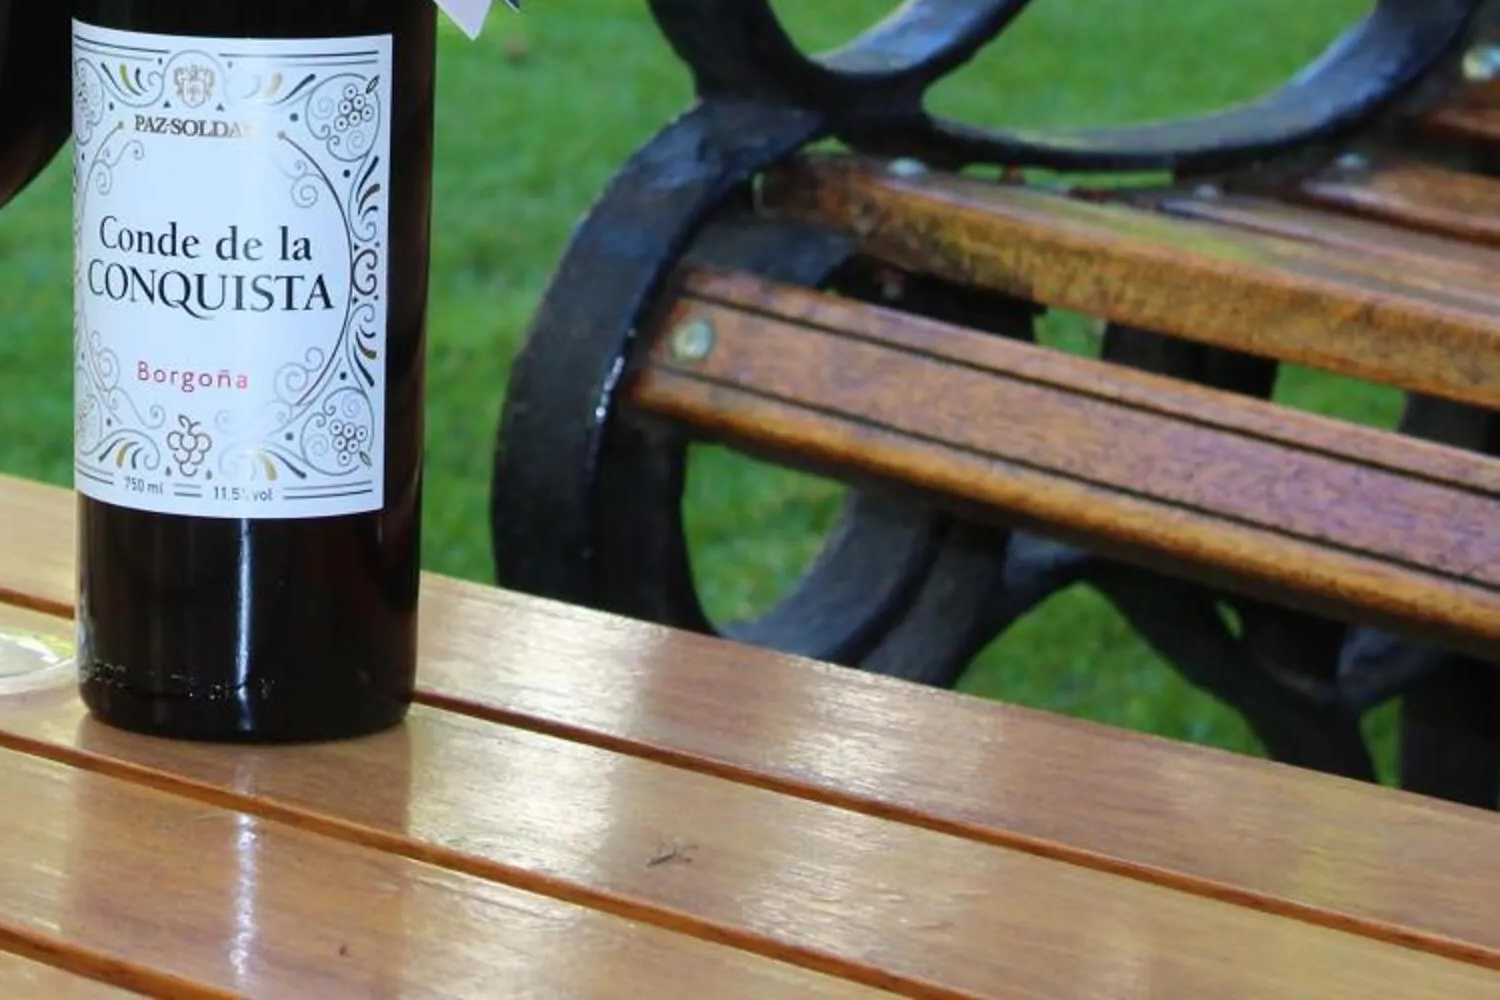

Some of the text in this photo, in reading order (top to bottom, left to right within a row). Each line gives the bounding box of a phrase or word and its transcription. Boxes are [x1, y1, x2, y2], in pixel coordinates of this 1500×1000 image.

[100, 215, 312, 261] Conde de la
[88, 259, 334, 319] CONQUISTA
[136, 360, 248, 393] Borgoña
[124, 476, 163, 495] 750 ml
